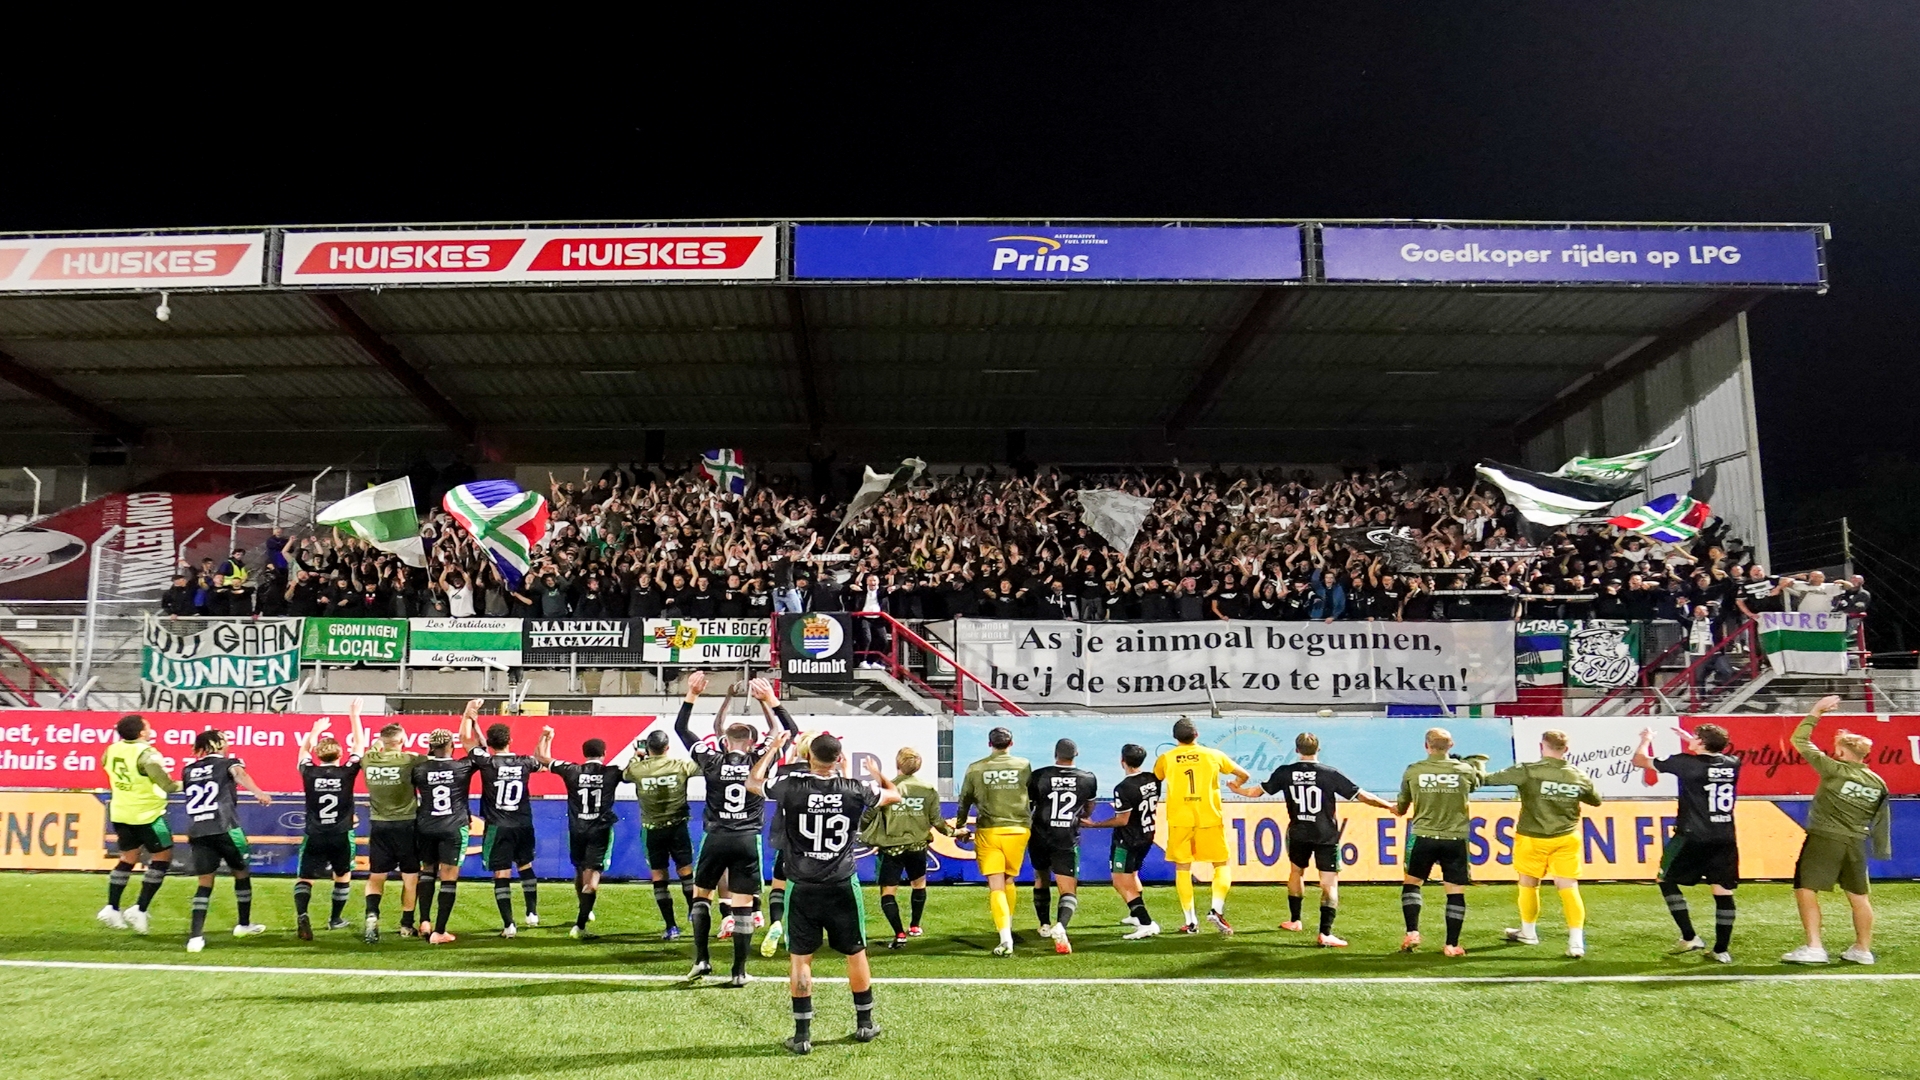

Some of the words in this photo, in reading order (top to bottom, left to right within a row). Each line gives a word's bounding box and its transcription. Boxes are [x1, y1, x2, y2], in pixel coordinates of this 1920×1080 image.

[63, 250, 216, 275] HUISKES
[329, 245, 490, 269] HUISKES
[561, 242, 727, 266] HUISKES
[992, 246, 1089, 272] Prins
[1400, 243, 1551, 264] Goedkoper
[1561, 244, 1637, 267] rijden
[1646, 249, 1680, 268] op
[1690, 245, 1741, 264] LPG
[328, 624, 398, 639] GRONINGEN
[425, 619, 445, 629] Los
[531, 620, 622, 632] MARTINI
[700, 622, 727, 635] TEN
[732, 622, 768, 636] BOER
[1763, 613, 1827, 630] NURG
[214, 620, 300, 655] GAAN
[327, 639, 397, 658] LOCALS
[532, 634, 620, 647] RAGAZZI
[1018, 627, 1062, 650] As
[1072, 628, 1104, 658] je
[1115, 626, 1253, 652] ainmoal
[1266, 627, 1443, 656] begunnen,
[431, 653, 443, 662] de
[703, 645, 721, 658] ON
[727, 644, 761, 658] TOUR
[150, 651, 291, 687] WINNEN
[788, 658, 847, 674] Oldambt
[990, 666, 1053, 697] he'j
[1066, 666, 1104, 693] de
[1116, 665, 1231, 693] smoak
[1241, 672, 1280, 691] zo
[1290, 668, 1321, 691] te
[1331, 666, 1469, 697] pakken!
[63, 751, 95, 771] én
[1879, 746, 1906, 765] in
[494, 780, 523, 806] 10
[1184, 769, 1195, 794] 1
[186, 781, 219, 814] 22
[319, 794, 338, 818] 2
[432, 785, 451, 811] 8
[577, 788, 602, 813] 11
[724, 783, 746, 813] 9
[1047, 791, 1077, 820] 12
[1289, 785, 1322, 814] 40
[1703, 783, 1734, 812] 18
[1, 811, 80, 856] NCE
[799, 813, 850, 853] 43
